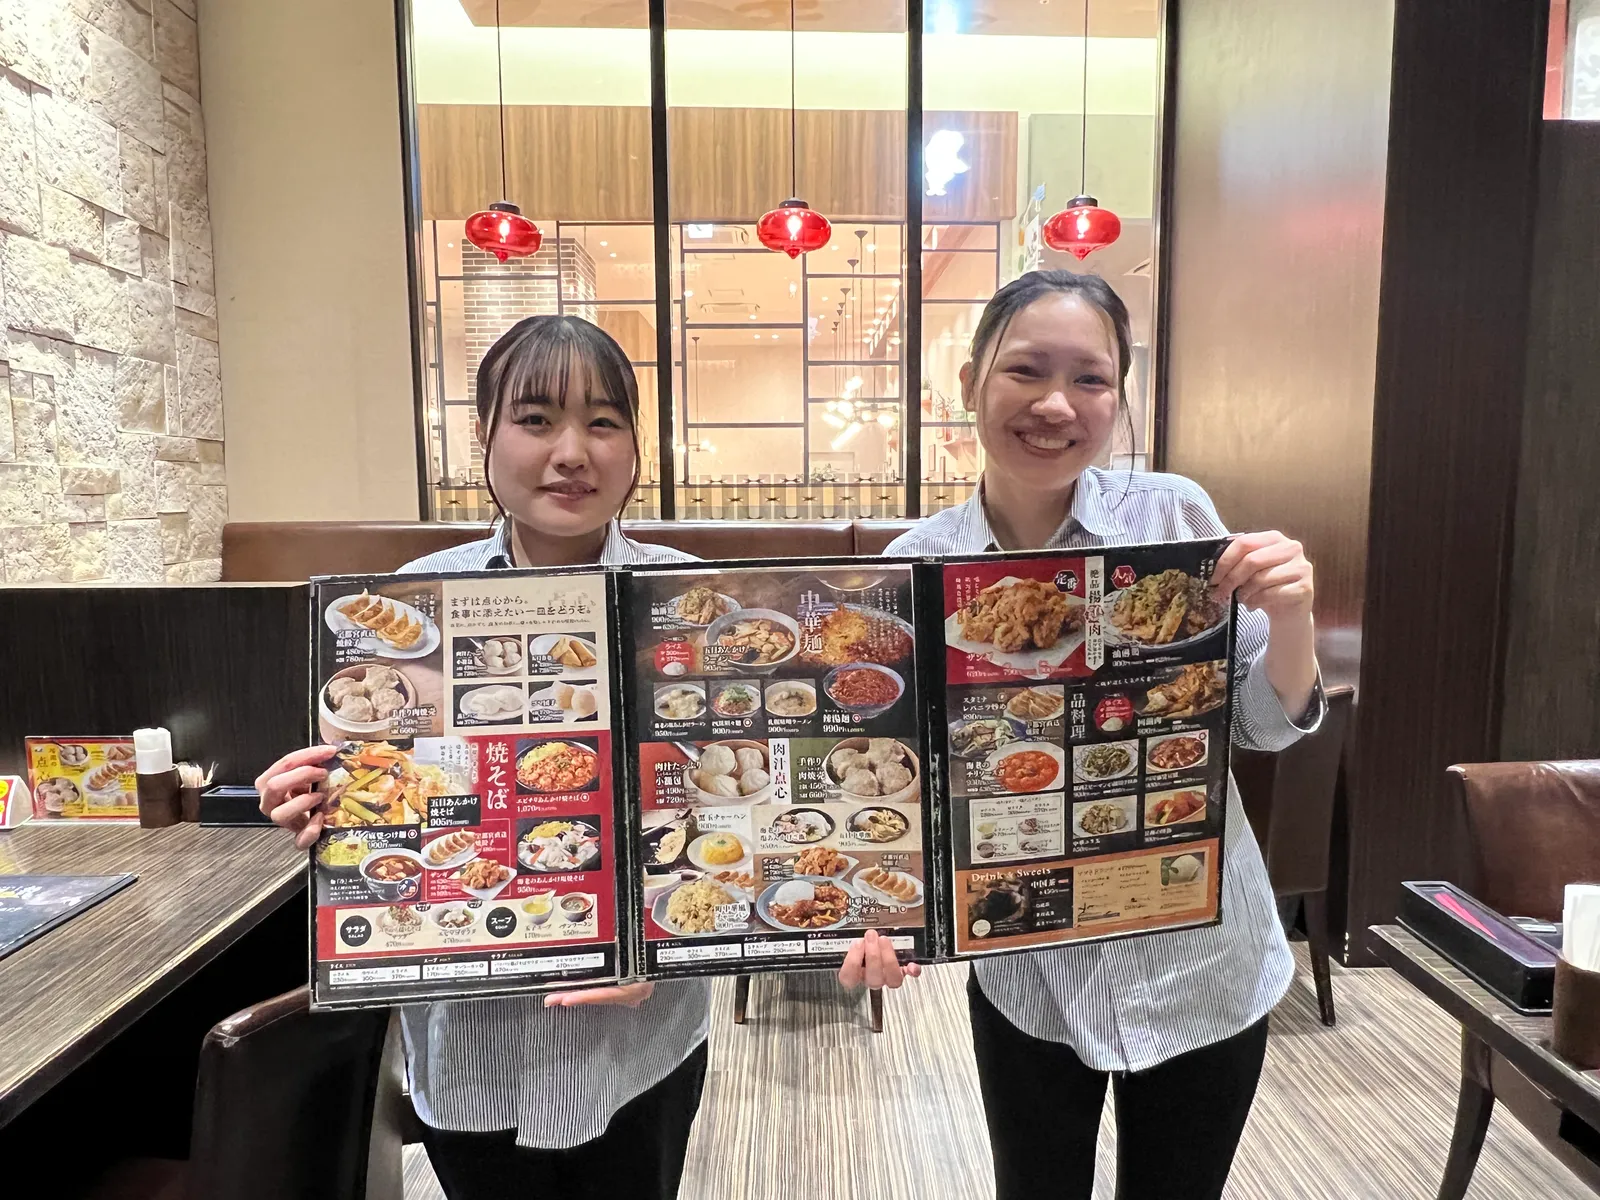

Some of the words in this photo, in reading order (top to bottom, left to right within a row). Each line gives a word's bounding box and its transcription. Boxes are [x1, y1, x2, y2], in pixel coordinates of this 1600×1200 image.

[450, 597, 528, 607] まずは点心から。
[451, 606, 592, 619] 食事に添えたい一皿をどうぞ。
[800, 590, 824, 655] 中華麺
[963, 696, 987, 704] スタミナ
[485, 741, 510, 810] 焼そば
[773, 743, 789, 799] 肉汁点心
[430, 797, 478, 808] 五目あんかけ
[430, 807, 455, 818] 焼そば
[971, 871, 1003, 886] Drink
[1018, 867, 1051, 880] Sweets
[491, 915, 512, 925] スープ
[345, 925, 367, 934] サラダ
